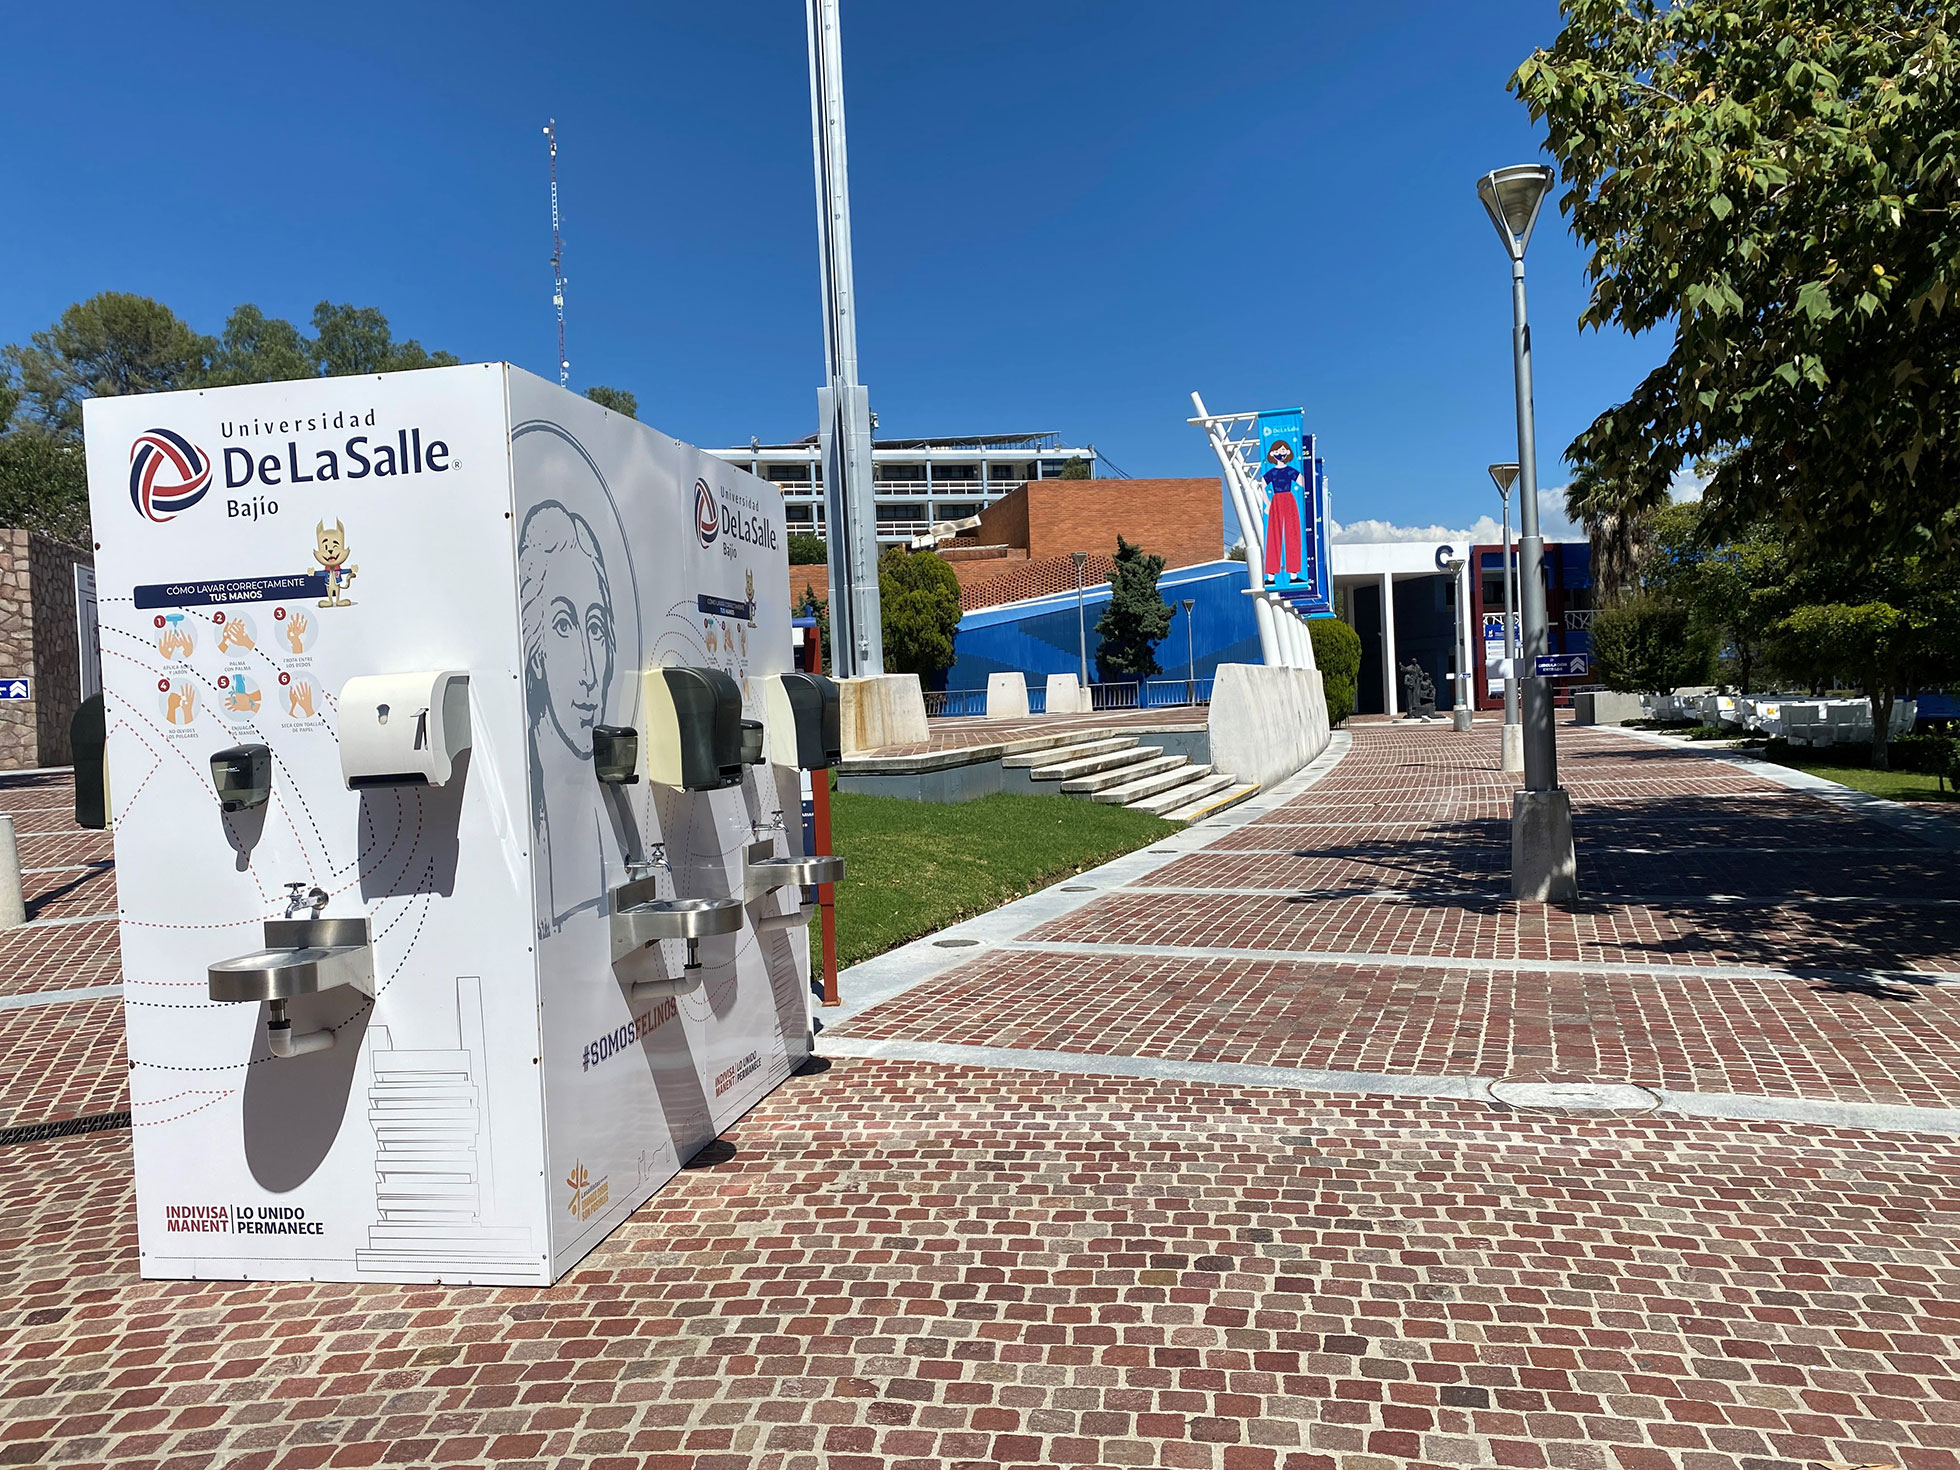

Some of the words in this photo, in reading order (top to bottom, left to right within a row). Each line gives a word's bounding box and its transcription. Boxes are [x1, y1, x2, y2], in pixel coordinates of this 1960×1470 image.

[220, 408, 376, 438] Universidad
[720, 485, 760, 512] Universidad
[226, 495, 279, 522] Bajío
[722, 541, 738, 561] Bajío
[1435, 545, 1455, 571] C
[166, 585, 195, 596] CÓMO
[197, 583, 226, 593] LAVAR
[226, 577, 306, 592] CORRECTAMENTE
[209, 593, 228, 602] TUS
[229, 590, 263, 601] MANOS
[582, 994, 679, 1073] #SOMOSFELINOS
[165, 1205, 229, 1219] INDIVISA
[236, 1206, 254, 1220] LO
[257, 1207, 305, 1220] UNIDO
[167, 1219, 229, 1233] MANENT
[238, 1221, 325, 1235] PERMANECE
